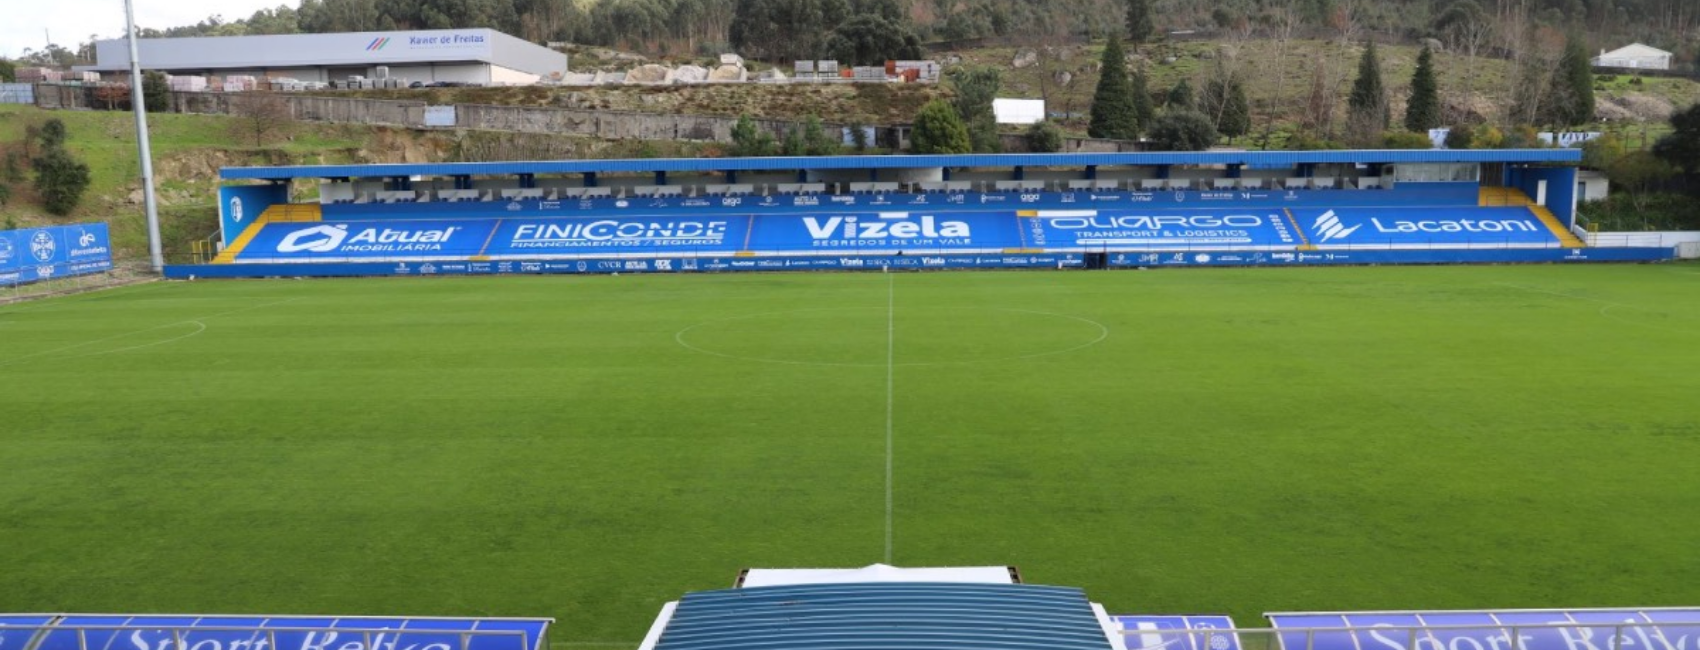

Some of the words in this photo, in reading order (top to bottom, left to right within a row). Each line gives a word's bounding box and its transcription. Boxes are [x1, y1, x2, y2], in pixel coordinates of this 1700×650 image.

[410, 36, 437, 45] Xavier
[440, 36, 451, 44] de
[454, 34, 484, 44] Freitas
[514, 220, 728, 241] FINICONDE
[802, 215, 972, 239] Vizela
[1371, 217, 1538, 232] Lacatoni
[346, 226, 457, 243] Atual
[340, 243, 442, 252] IMOBILIÁRIA
[510, 238, 642, 249] FINANCIAMENTOS
[653, 237, 723, 247] SEGUROS
[812, 239, 887, 247] SEGREDOS
[940, 238, 972, 246] VALE
